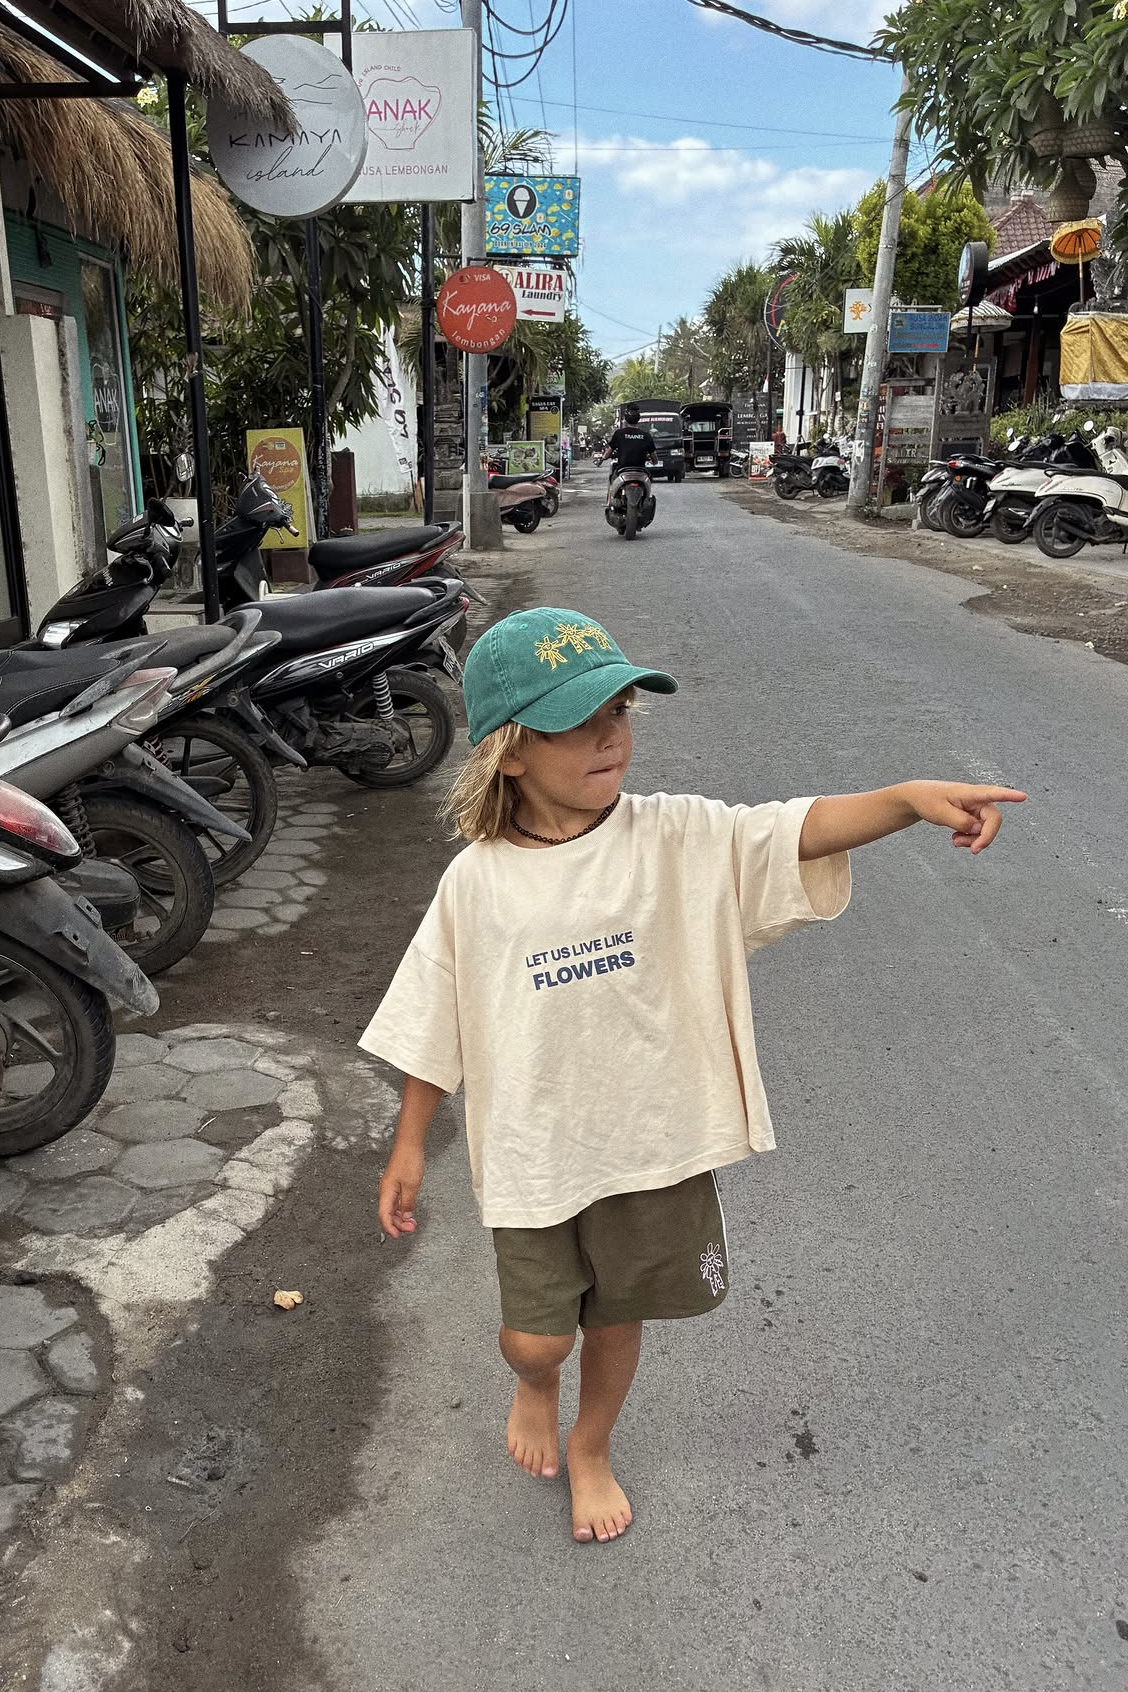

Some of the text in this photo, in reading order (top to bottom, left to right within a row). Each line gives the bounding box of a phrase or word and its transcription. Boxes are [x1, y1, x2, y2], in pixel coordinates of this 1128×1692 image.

[361, 64, 383, 77] ISLAND
[366, 98, 434, 121] ANAK
[228, 128, 342, 148] KAMAYA
[246, 143, 333, 182] island
[361, 164, 449, 176] USA LEMBONGAN
[489, 222, 552, 237] 69 SLAM
[473, 273, 491, 281] VISA
[514, 271, 564, 292] ALIRA
[521, 289, 563, 302] Laundry
[442, 290, 512, 331] Kayana
[451, 327, 506, 349] lembongan
[94, 387, 119, 413] ANAK
[252, 454, 299, 475] Kayana
[366, 562, 401, 580] VARIO
[318, 642, 375, 669] VARIO
[525, 930, 634, 968] LET US LIVE LIKE
[532, 950, 636, 991] FLOWERS
